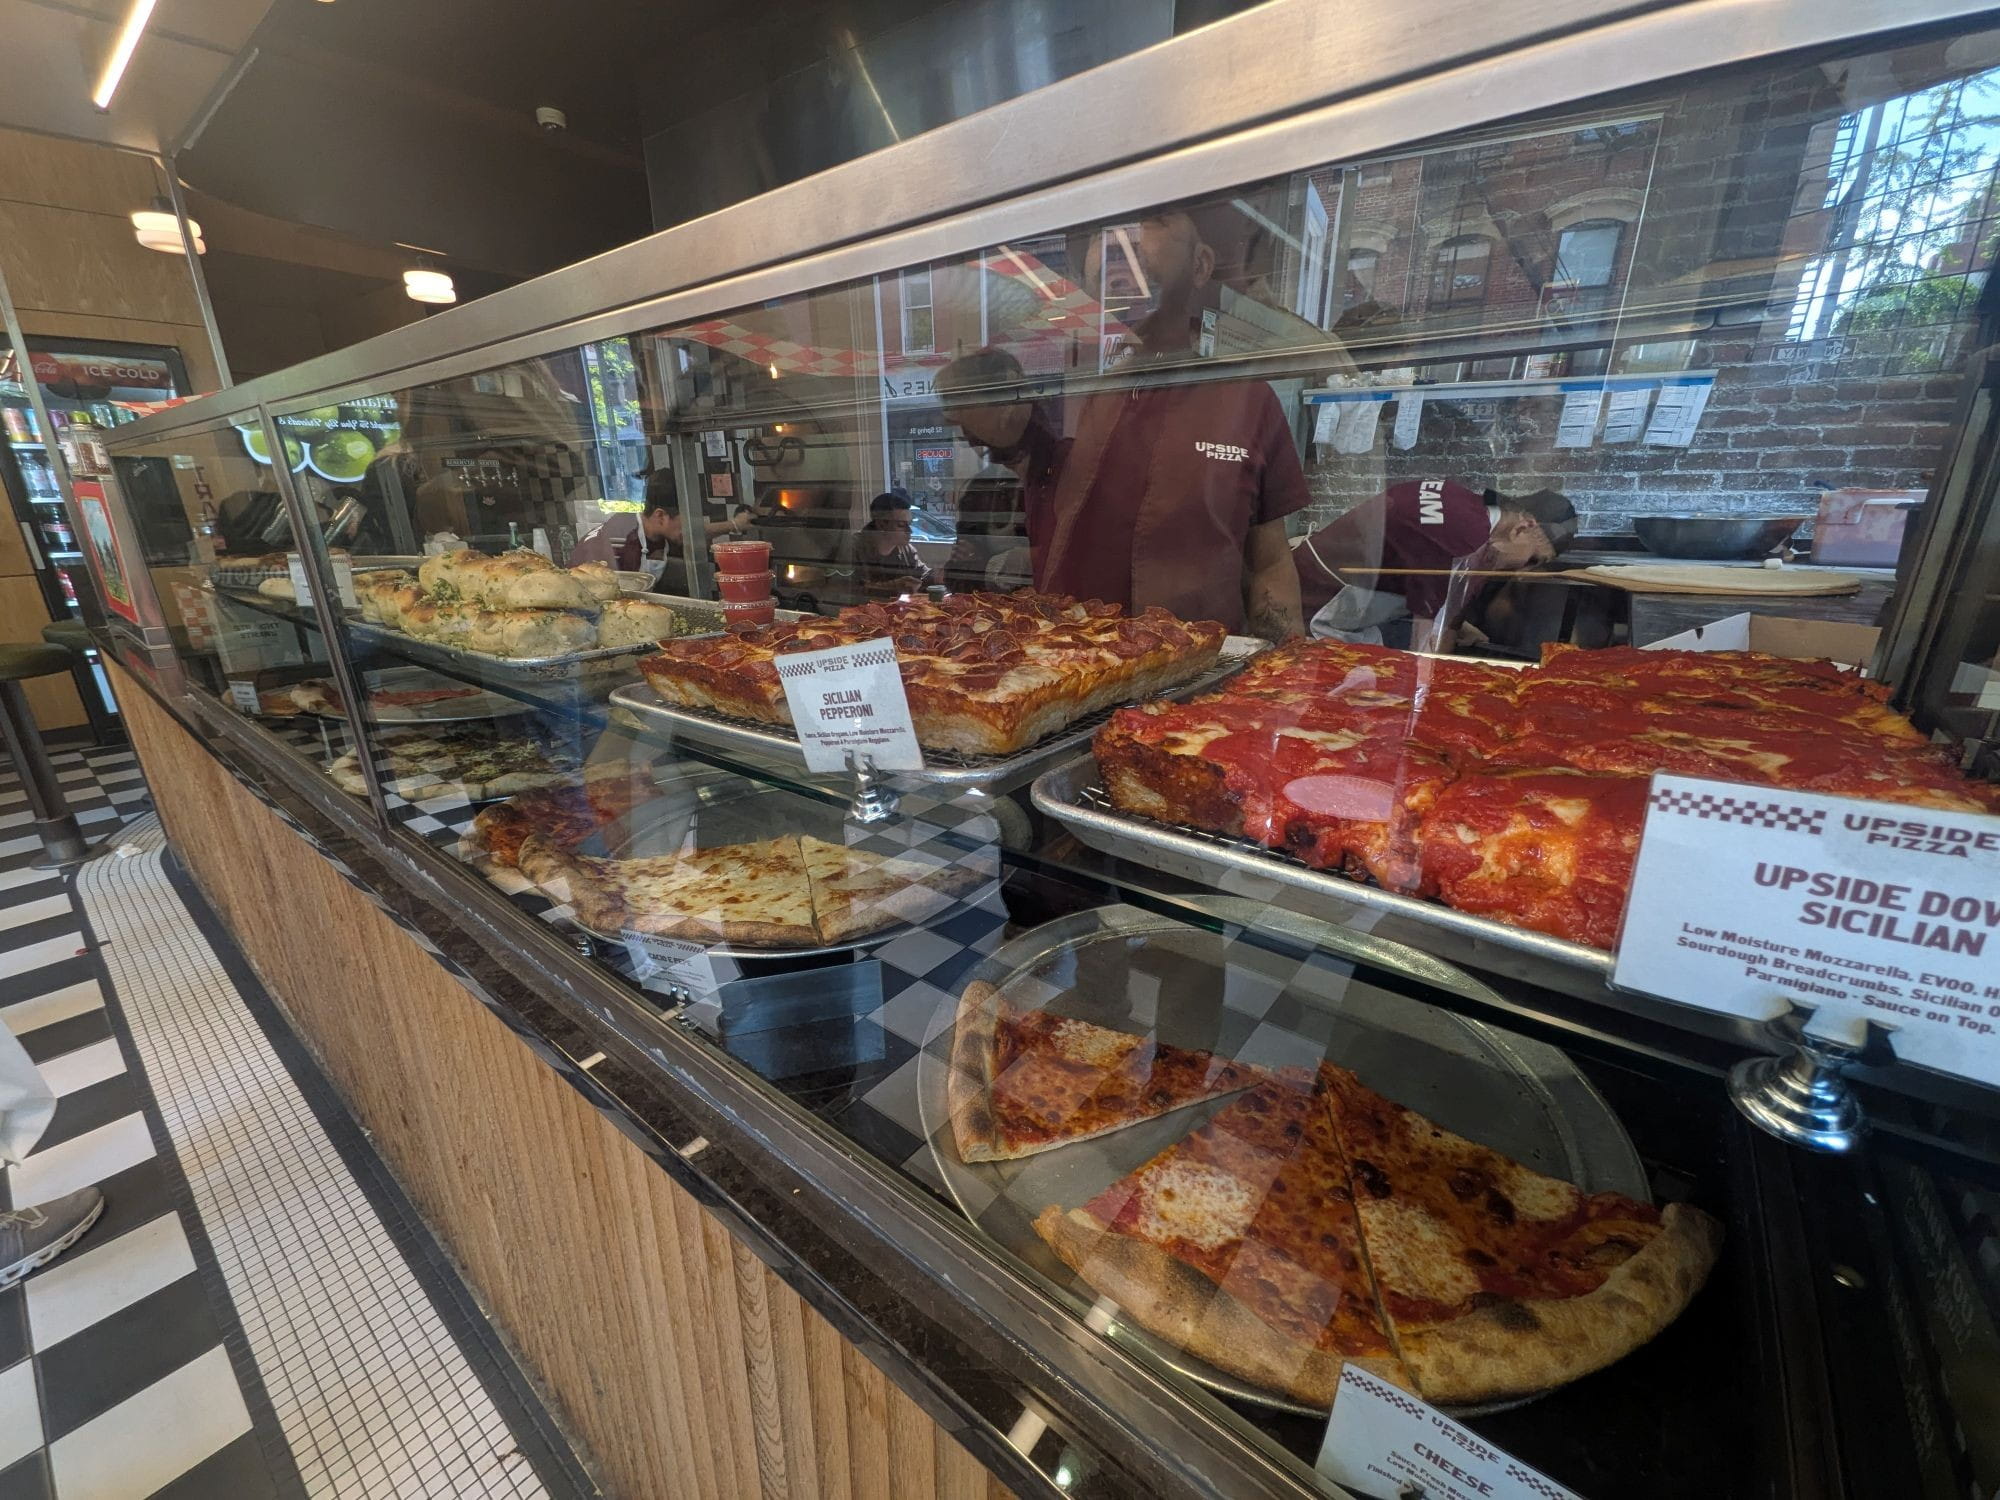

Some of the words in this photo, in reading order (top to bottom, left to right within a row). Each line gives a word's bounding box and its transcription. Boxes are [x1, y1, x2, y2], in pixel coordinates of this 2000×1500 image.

[83, 365, 111, 377] ICE
[116, 367, 160, 380] COLD
[1195, 441, 1249, 458] UPSIDE
[1206, 451, 1242, 462] PIZZA
[1419, 480, 1445, 524] EAM
[816, 655, 849, 668] UPSIDE
[823, 664, 846, 672] PIZZA
[819, 703, 874, 720] PEPPERONI
[822, 689, 863, 706] SICILIAN
[1843, 813, 2000, 851] UPSIDE
[1867, 832, 1969, 858] PIZZA
[1754, 862, 1912, 912] UPSIDE
[1682, 922, 1718, 938] Low
[1721, 930, 1800, 957] Moisture
[1798, 901, 1988, 957] SICILIAN
[1677, 936, 1768, 965] Sourdough
[1910, 988, 1983, 1014] Sicilian
[1745, 966, 1848, 999] Parmigiano
[1862, 994, 1921, 1017] Sauce
[1926, 1011, 1950, 1024] on
[1957, 1014, 1997, 1035] Top.
[1431, 1416, 1501, 1465] UPSIDE
[1440, 1429, 1486, 1461] PIZZA
[1367, 1463, 1403, 1485] Finished
[1386, 1456, 1405, 1470] Low
[1406, 1467, 1445, 1496] Moisture
[1390, 1450, 1419, 1471] Sauce,
[1420, 1467, 1447, 1489] Fresh
[1413, 1442, 1494, 1498] CHEESE
